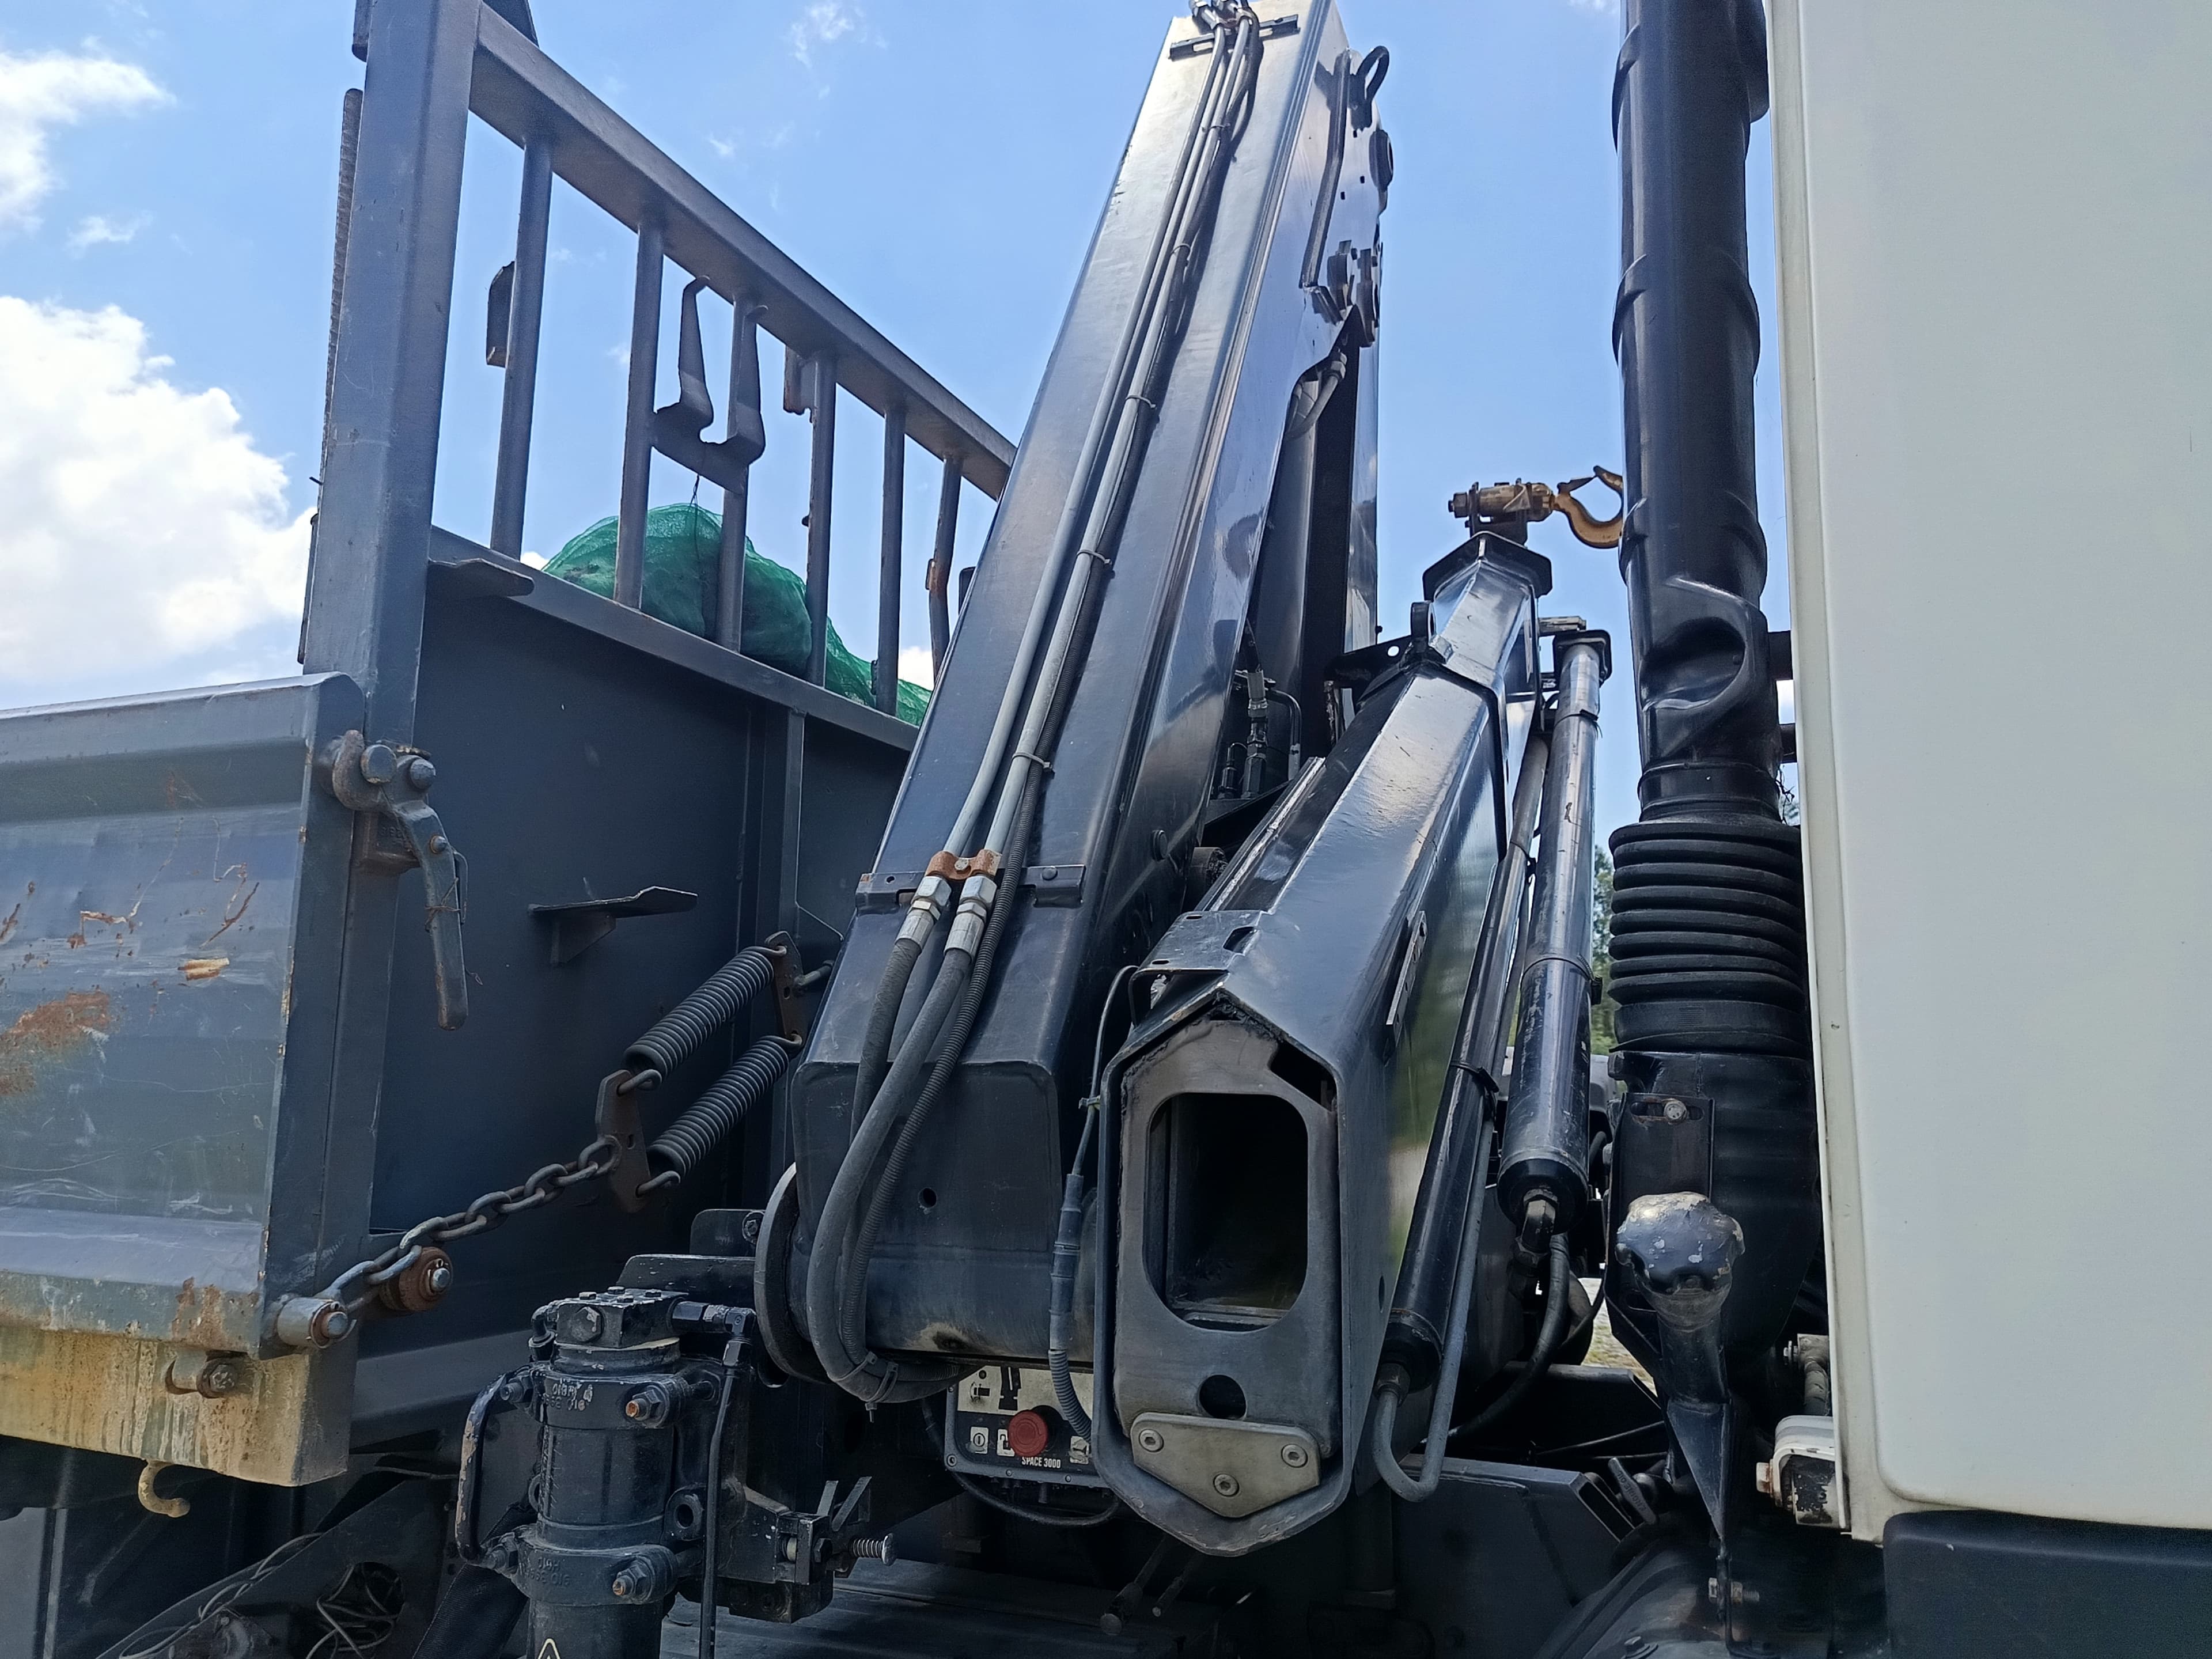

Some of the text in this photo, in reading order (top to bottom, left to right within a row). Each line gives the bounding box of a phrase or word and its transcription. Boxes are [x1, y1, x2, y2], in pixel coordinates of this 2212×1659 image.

[1021, 1456, 1061, 1468] SPACE 3000
[1617, 1469, 1627, 1484] OIL
